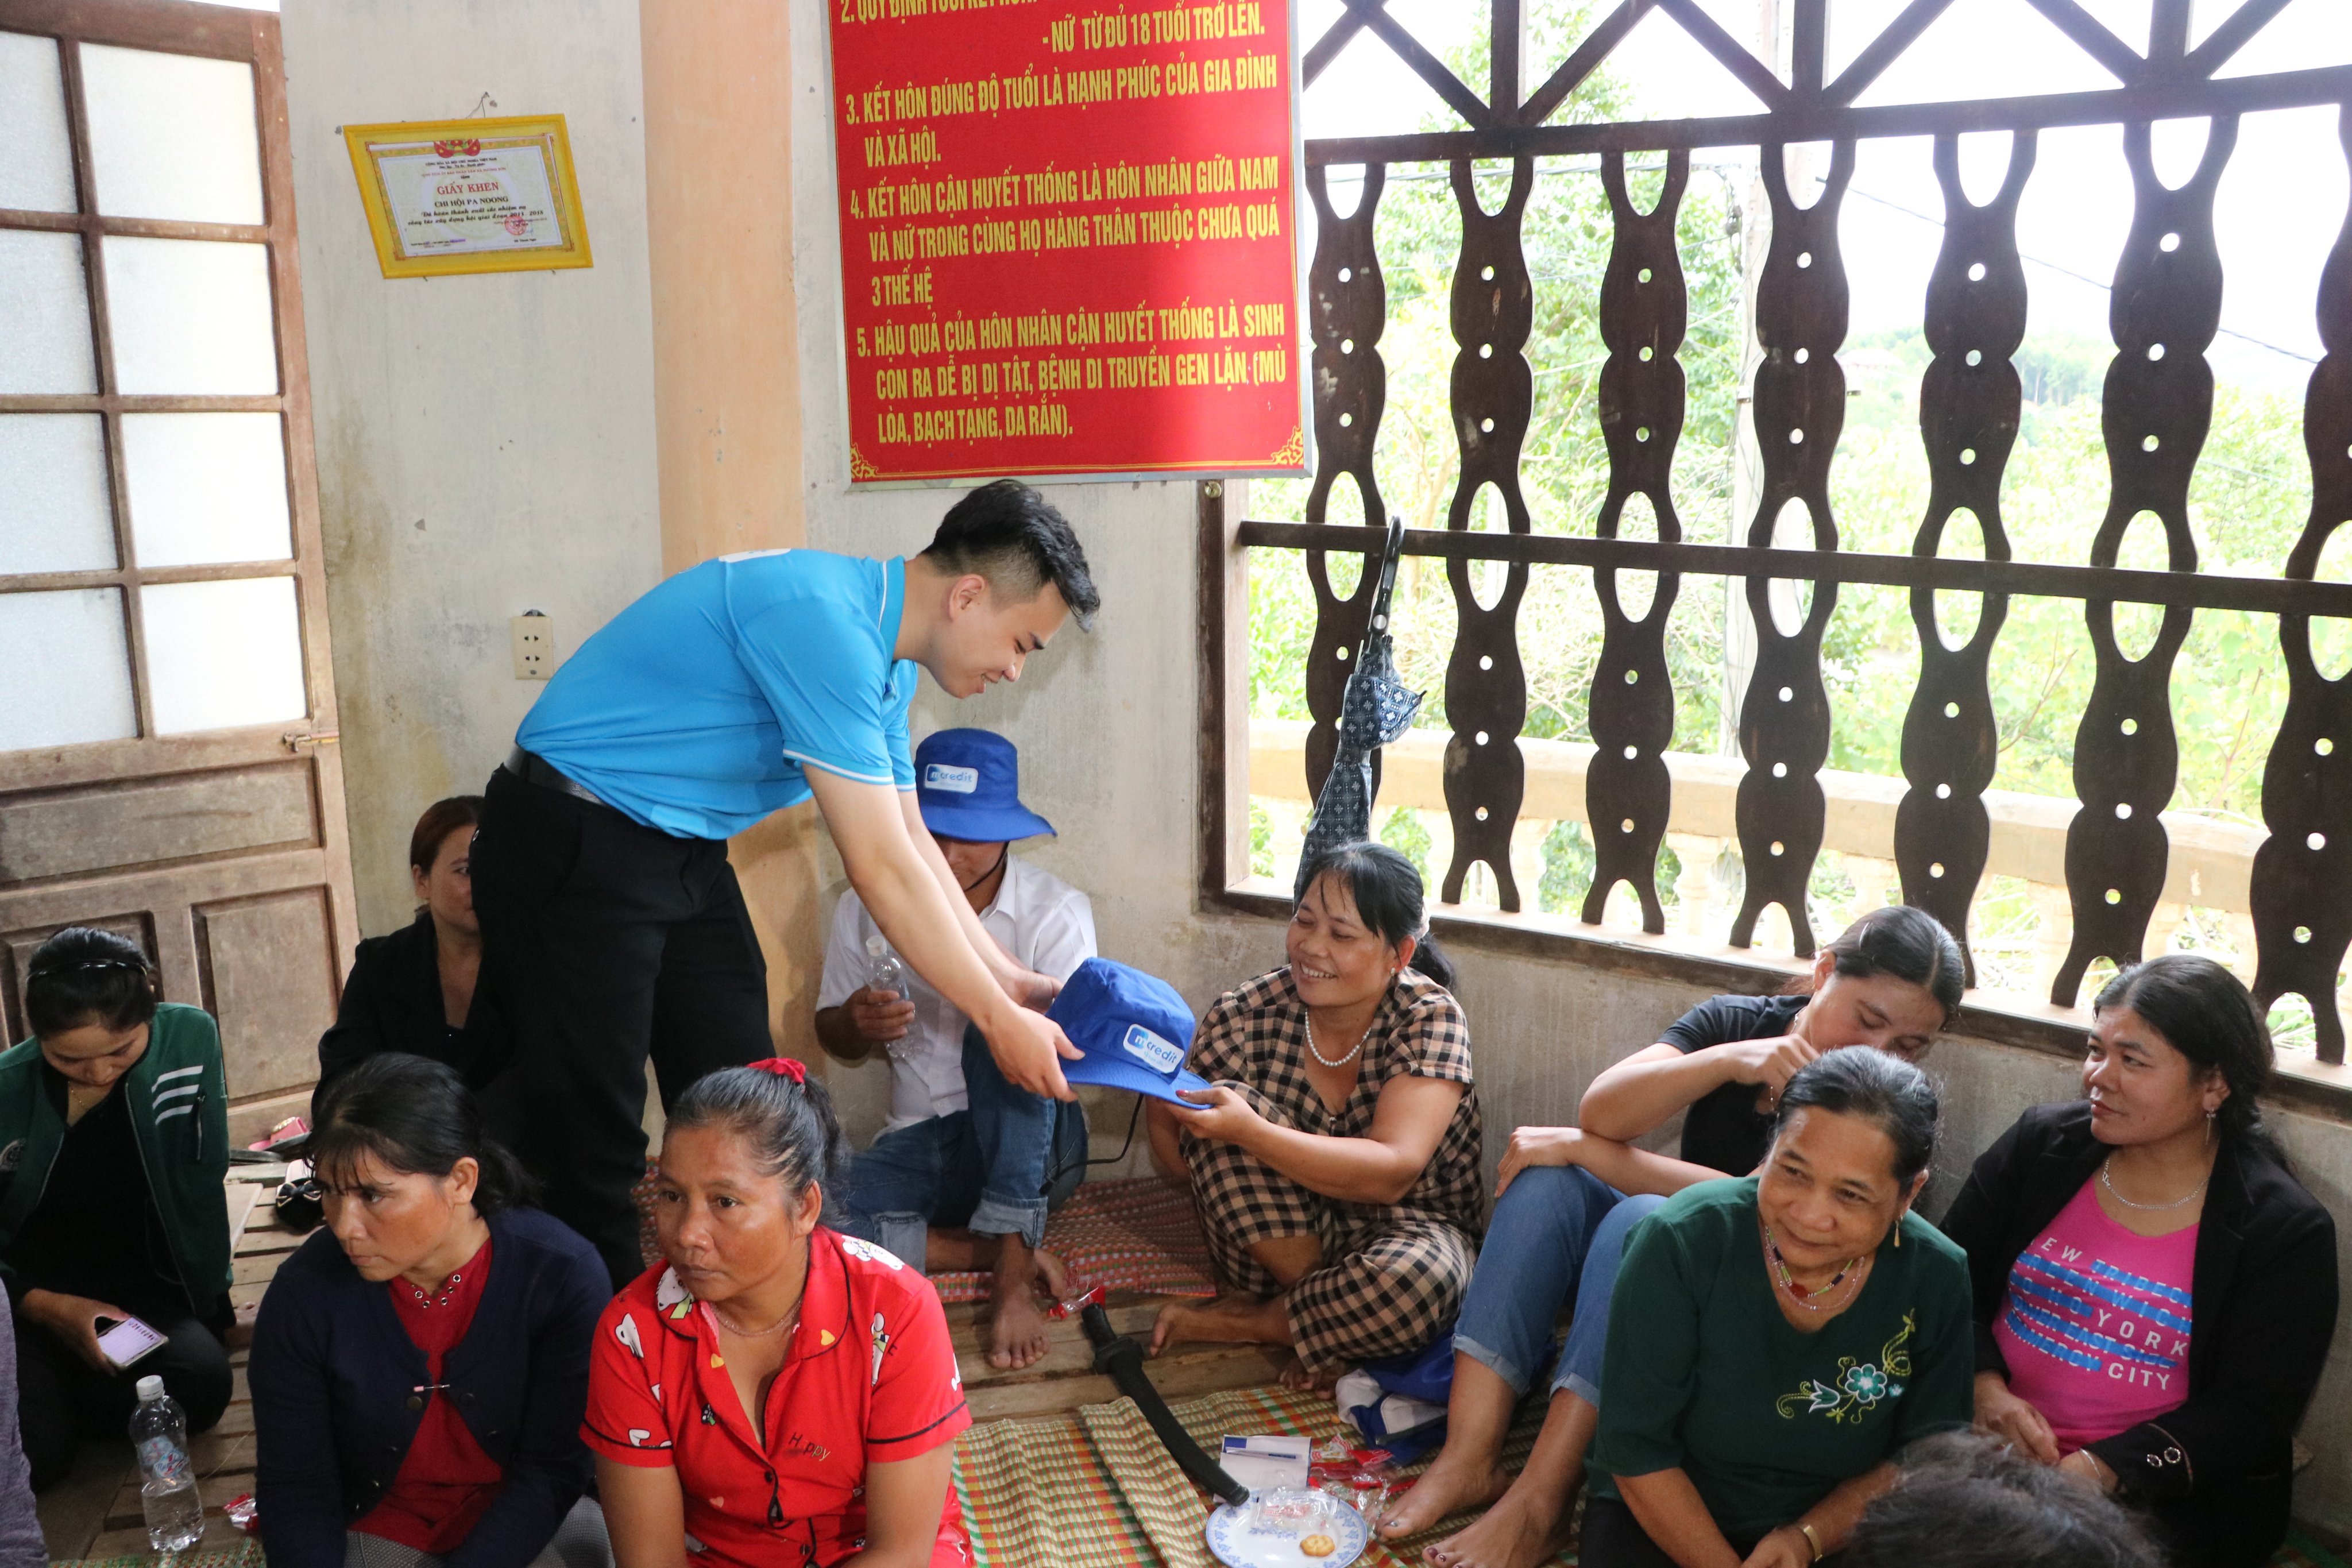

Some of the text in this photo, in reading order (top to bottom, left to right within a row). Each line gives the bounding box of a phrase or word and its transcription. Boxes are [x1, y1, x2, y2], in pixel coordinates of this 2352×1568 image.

[840, 0, 855, 23] 2.
[1051, 13, 1076, 53] NỮ
[1082, 10, 1103, 50] TỪ
[1104, 3, 1127, 48] ĐỦ
[1130, 12, 1151, 45] 18
[1152, 0, 1191, 44] TUỔI
[1227, 0, 1266, 37] LÊN.
[845, 48, 1278, 125] 3. KẾT HÔN ĐÚNG ĐỘ TUỔI LÀ HẠNH PHÚC CỦA GIA ĐÌNH
[864, 125, 941, 169] VÀ XÃ HỘI.
[437, 181, 499, 195] GIẤY KHEN
[451, 199, 465, 207] HỘI
[468, 198, 478, 206] PA
[480, 196, 509, 204] NOONG
[850, 153, 1280, 219] 4. KẾT HÔN CẬN HUYẾT THỐNG LÀ HÔN NHÂN GIỮA NAM
[869, 195, 1281, 262] VÀ NỮ TRONG CÙNG HỌ HÀNG THÂN THUỘC CHƯA QUÁ
[871, 264, 933, 310] 3 THẾ HỆ
[857, 295, 1286, 362] 5. HẬU QUẢ CỦA HÔN NHÂN CẬN HUYẾT THỐNG LÀ SINH
[876, 342, 1287, 401] CON RA DỄ BỊ DỊ TẬT, BỆNH DI TRUYỀN GEN LẶN (MÙ
[878, 392, 1073, 448] LÒA, BẠCH TẠNG, DA RẮN).
[2031, 1237, 2083, 1262] EW
[2098, 1308, 2188, 1357] YORK
[2108, 1362, 2171, 1391] CITY
